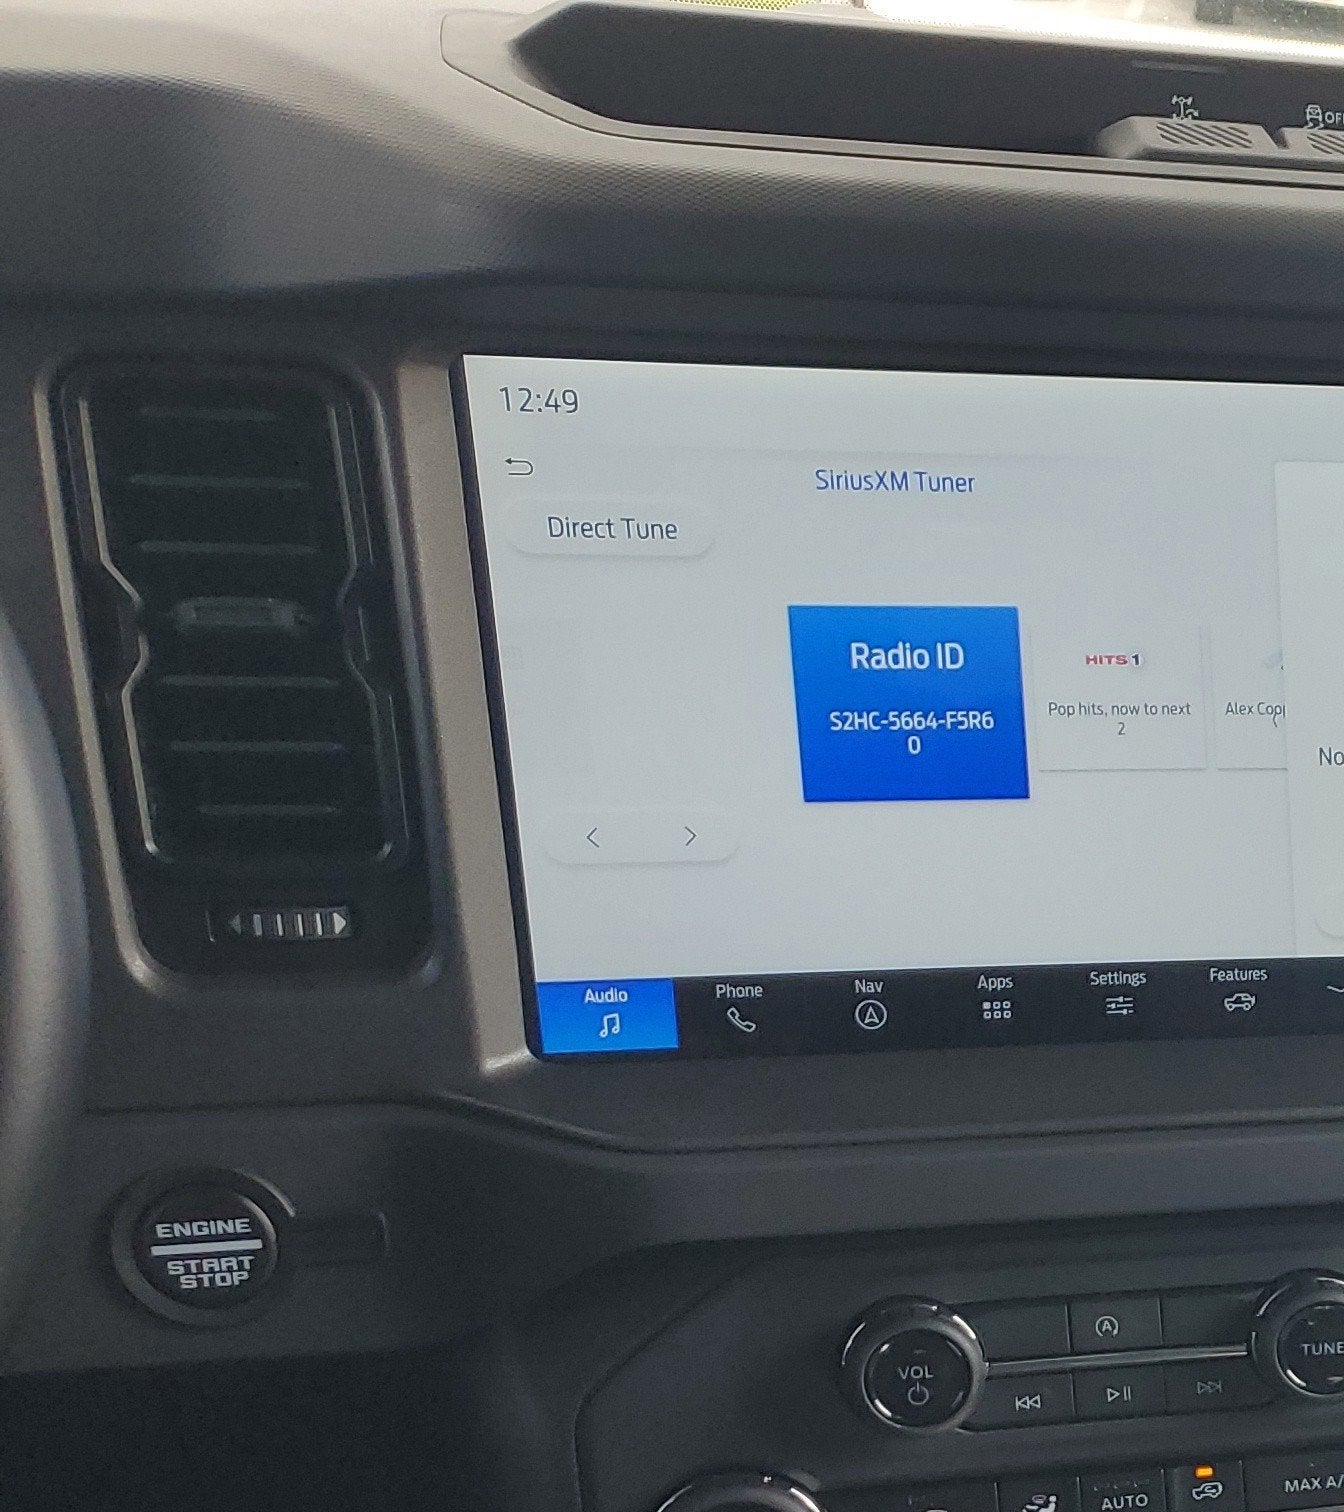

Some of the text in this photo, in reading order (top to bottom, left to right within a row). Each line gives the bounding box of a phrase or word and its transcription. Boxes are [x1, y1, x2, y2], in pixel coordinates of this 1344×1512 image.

[499, 386, 579, 414] 12:49
[815, 469, 975, 494] SiriusXM Tuner
[547, 516, 678, 541] Direct Tune
[850, 642, 966, 671] Radio ID
[1048, 702, 1191, 718] Pop hits, now to next
[1225, 701, 1255, 716] Alex
[829, 711, 994, 731] S2HC-5664-F5R6
[1117, 722, 1126, 736] 2
[907, 736, 920, 755] 0
[977, 973, 1014, 992] Apps
[1090, 970, 1146, 986] Settings
[1210, 966, 1268, 982] Features
[715, 982, 763, 998] Phone
[854, 978, 884, 995] Nav
[584, 987, 628, 1004] Audio
[155, 1218, 250, 1238] ENGINE
[167, 1256, 256, 1276] START
[178, 1272, 250, 1289] STOP
[899, 1366, 933, 1380] VOL
[1284, 1479, 1322, 1492] MAX
[1101, 1494, 1149, 1511] AUTO
